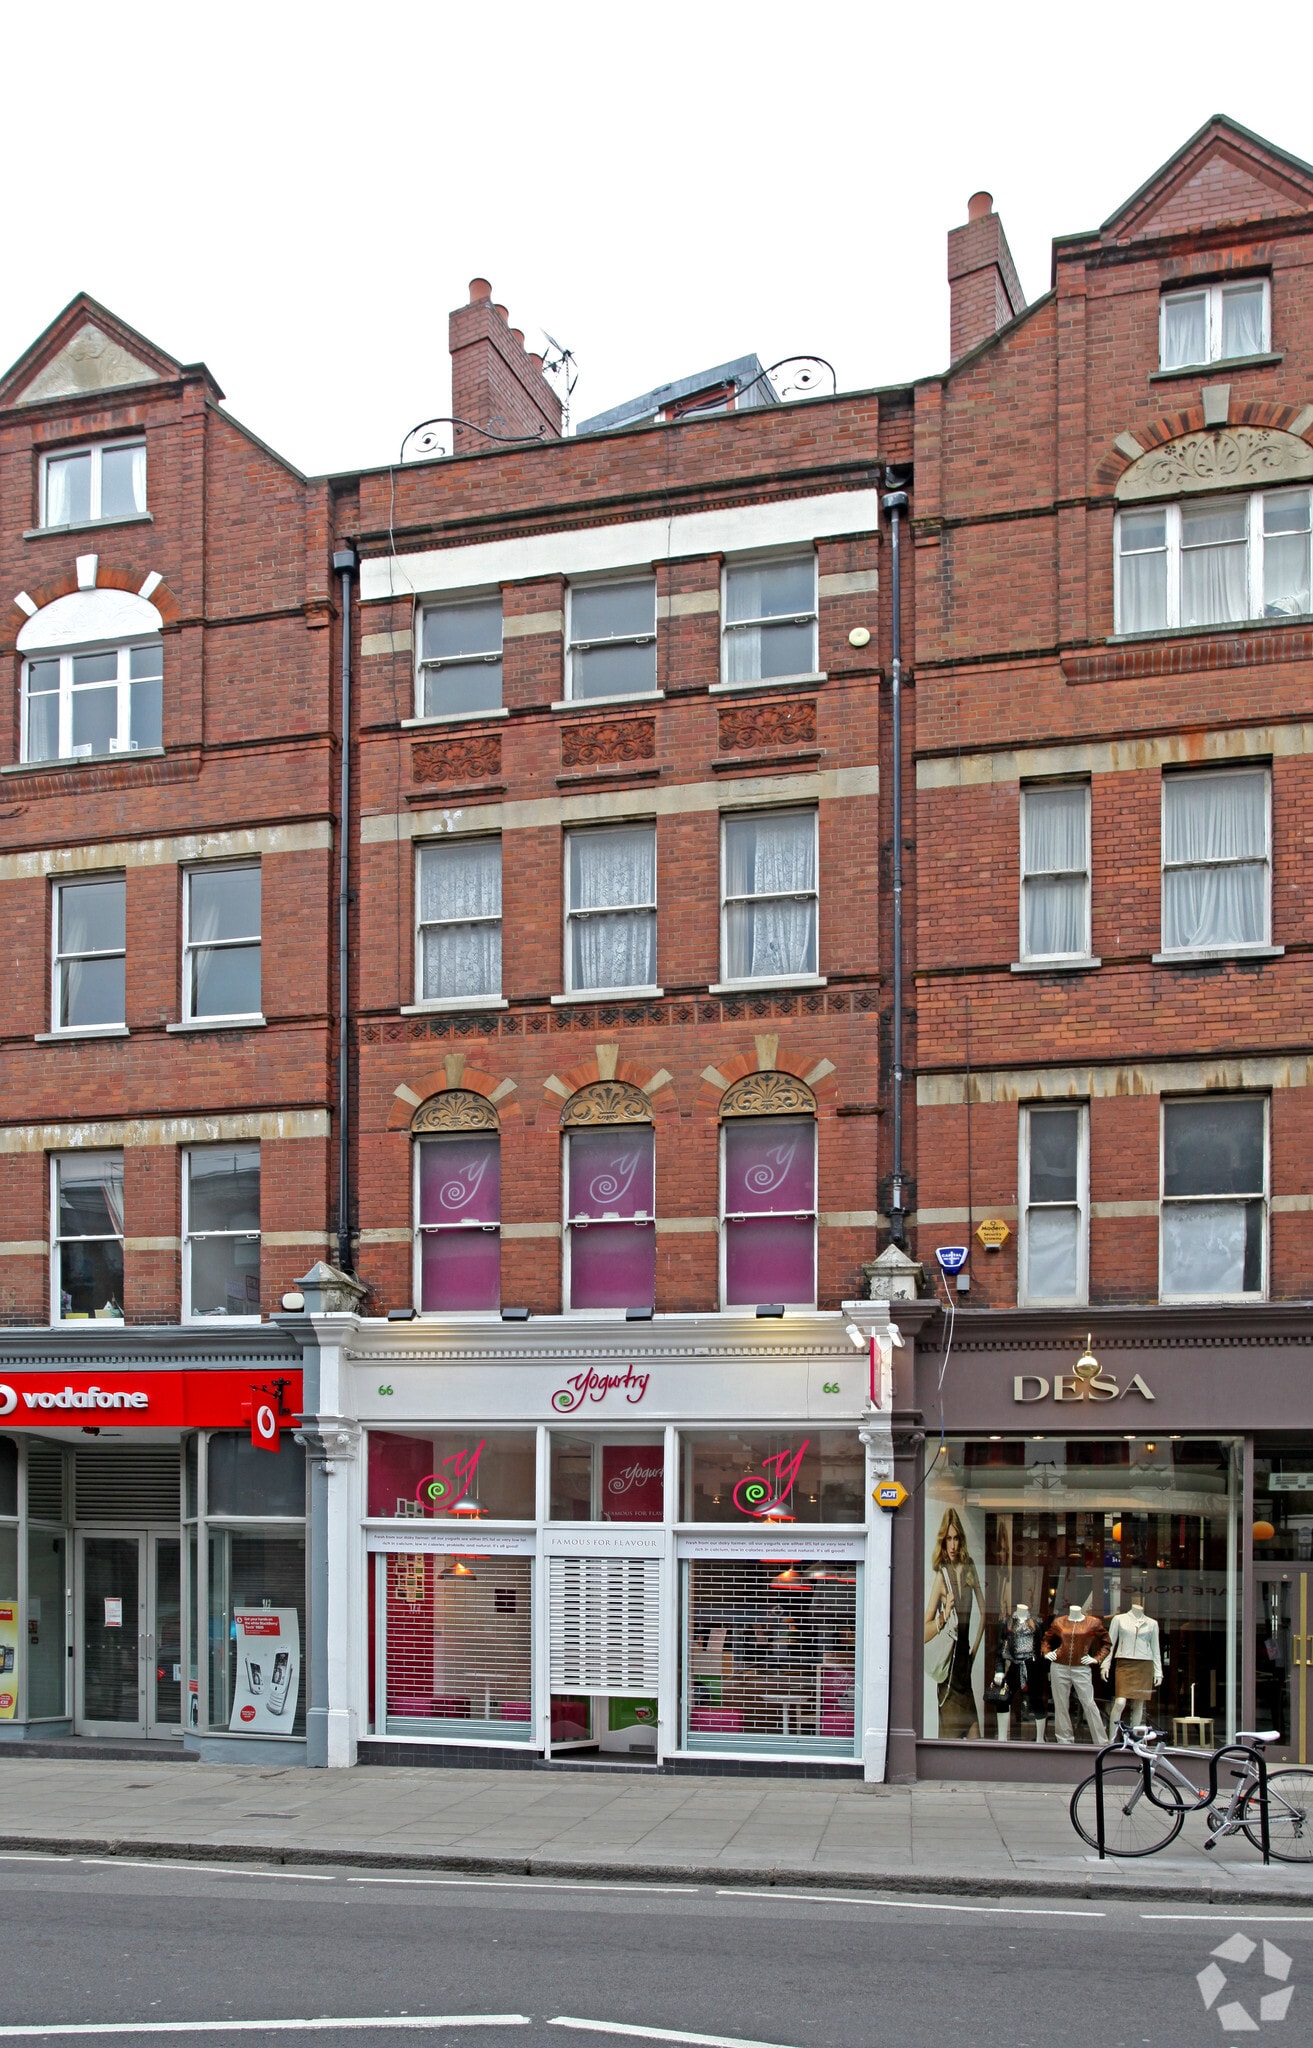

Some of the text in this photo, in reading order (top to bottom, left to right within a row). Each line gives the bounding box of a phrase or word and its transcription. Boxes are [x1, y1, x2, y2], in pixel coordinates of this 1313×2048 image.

[378, 1384, 394, 1396] 66
[551, 1363, 650, 1413] Yogurtry
[822, 1381, 841, 1394] 66
[1013, 1373, 1155, 1404] DESA
[22, 1386, 148, 1408] vodafone
[881, 1490, 897, 1498] ADT
[634, 1510, 647, 1518] FOR
[551, 1538, 591, 1546] FAMOUS
